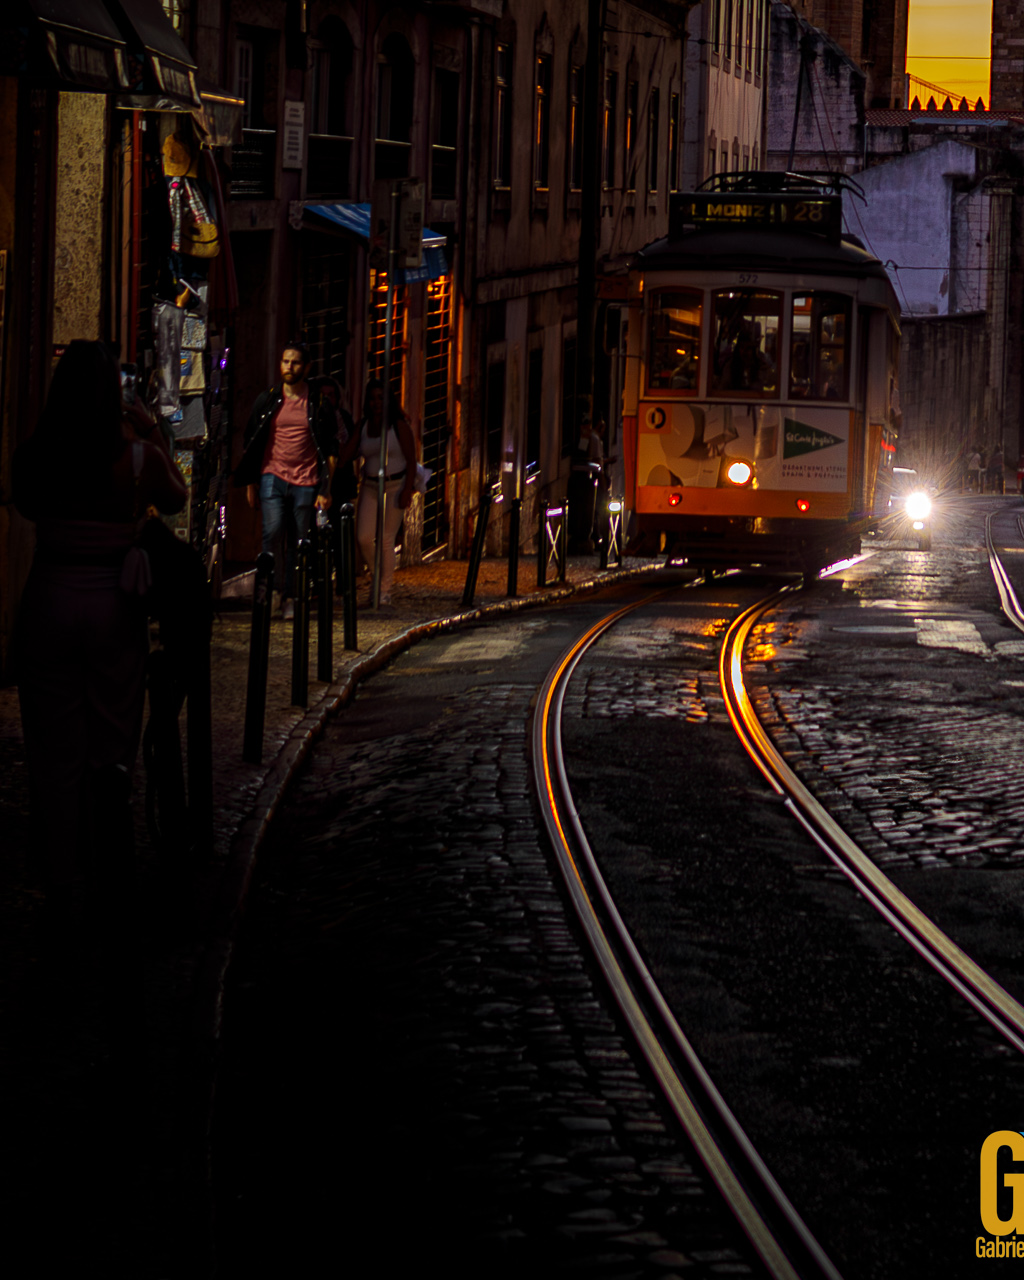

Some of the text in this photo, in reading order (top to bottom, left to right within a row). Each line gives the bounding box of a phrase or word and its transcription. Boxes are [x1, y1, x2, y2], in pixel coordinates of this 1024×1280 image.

[707, 203, 766, 218] MONIZ
[793, 204, 823, 221] 28
[739, 274, 759, 284] 572
